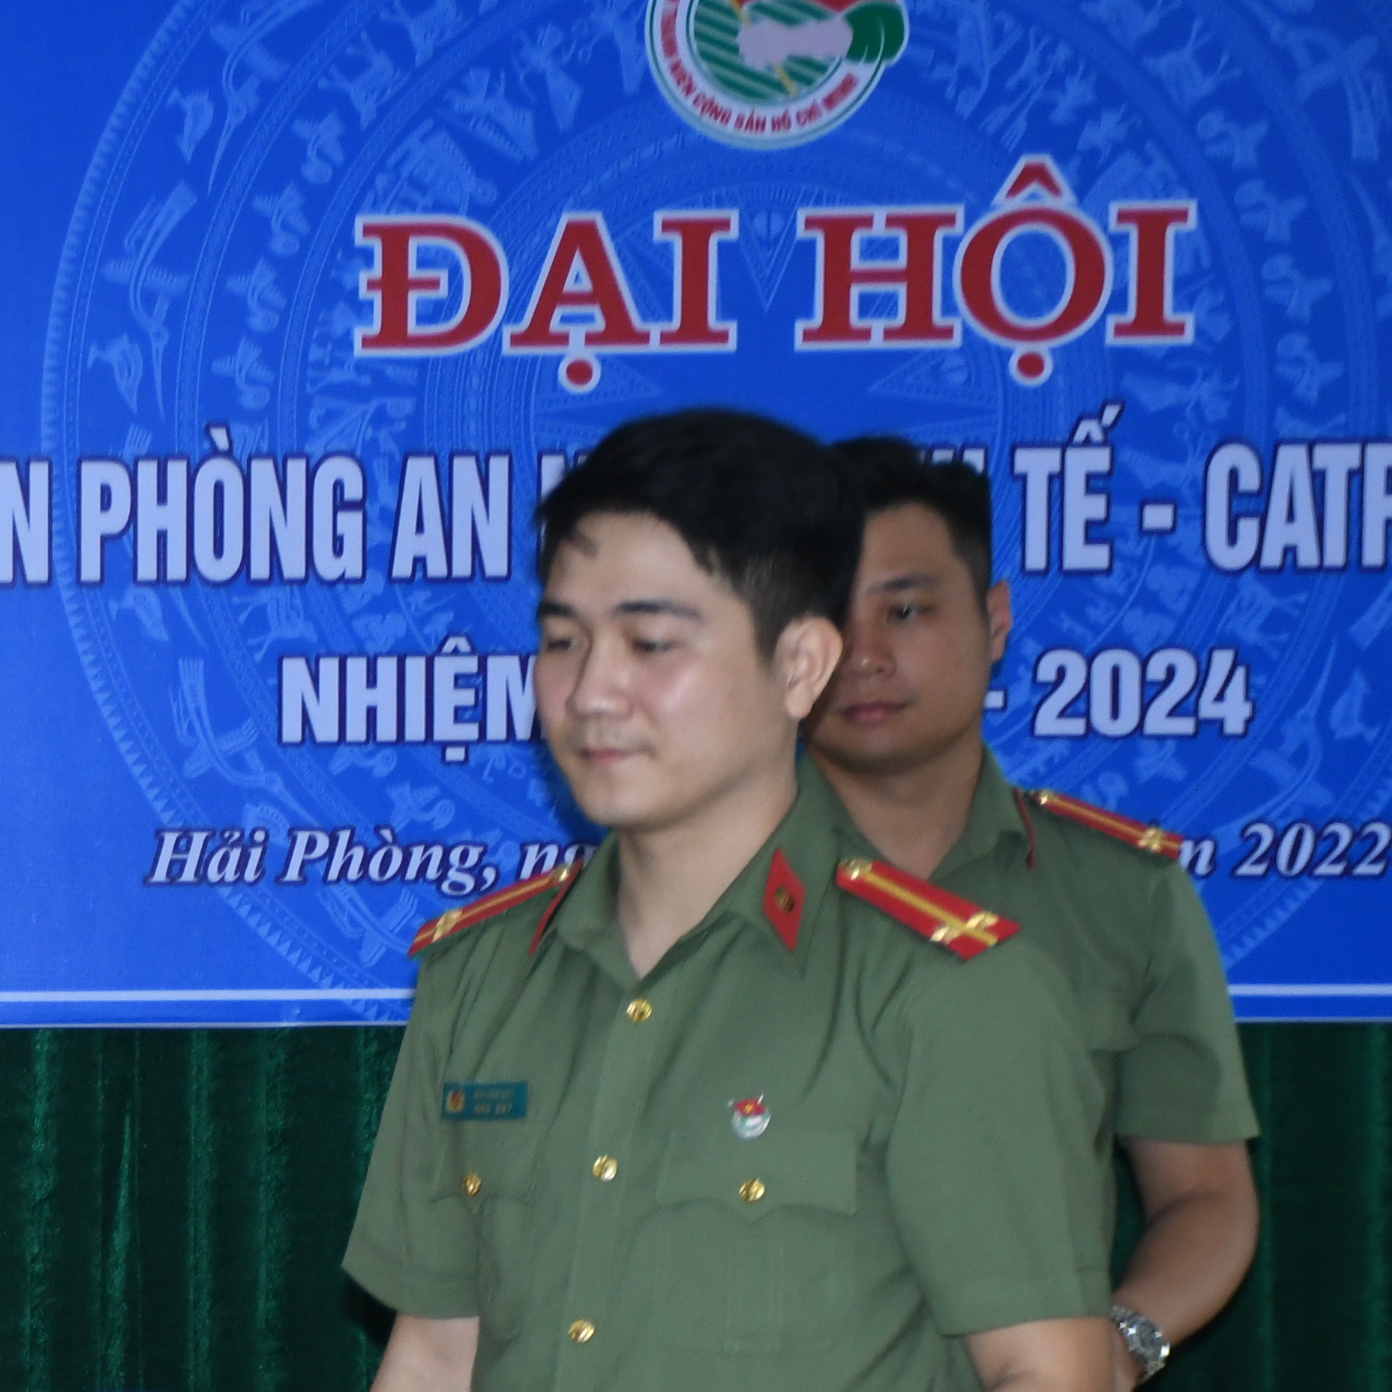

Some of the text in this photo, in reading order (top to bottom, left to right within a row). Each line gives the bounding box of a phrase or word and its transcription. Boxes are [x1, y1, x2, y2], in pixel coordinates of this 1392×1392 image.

[355, 154, 1196, 391] ĐẠI HỘI
[79, 426, 366, 583] PHÒNG
[390, 453, 512, 580] AN
[1013, 403, 1121, 572] TẾ
[1033, 648, 1253, 737] 2024
[146, 827, 269, 884] Hải
[278, 827, 498, 897] Phòng,
[1233, 821, 1391, 878] 2022
